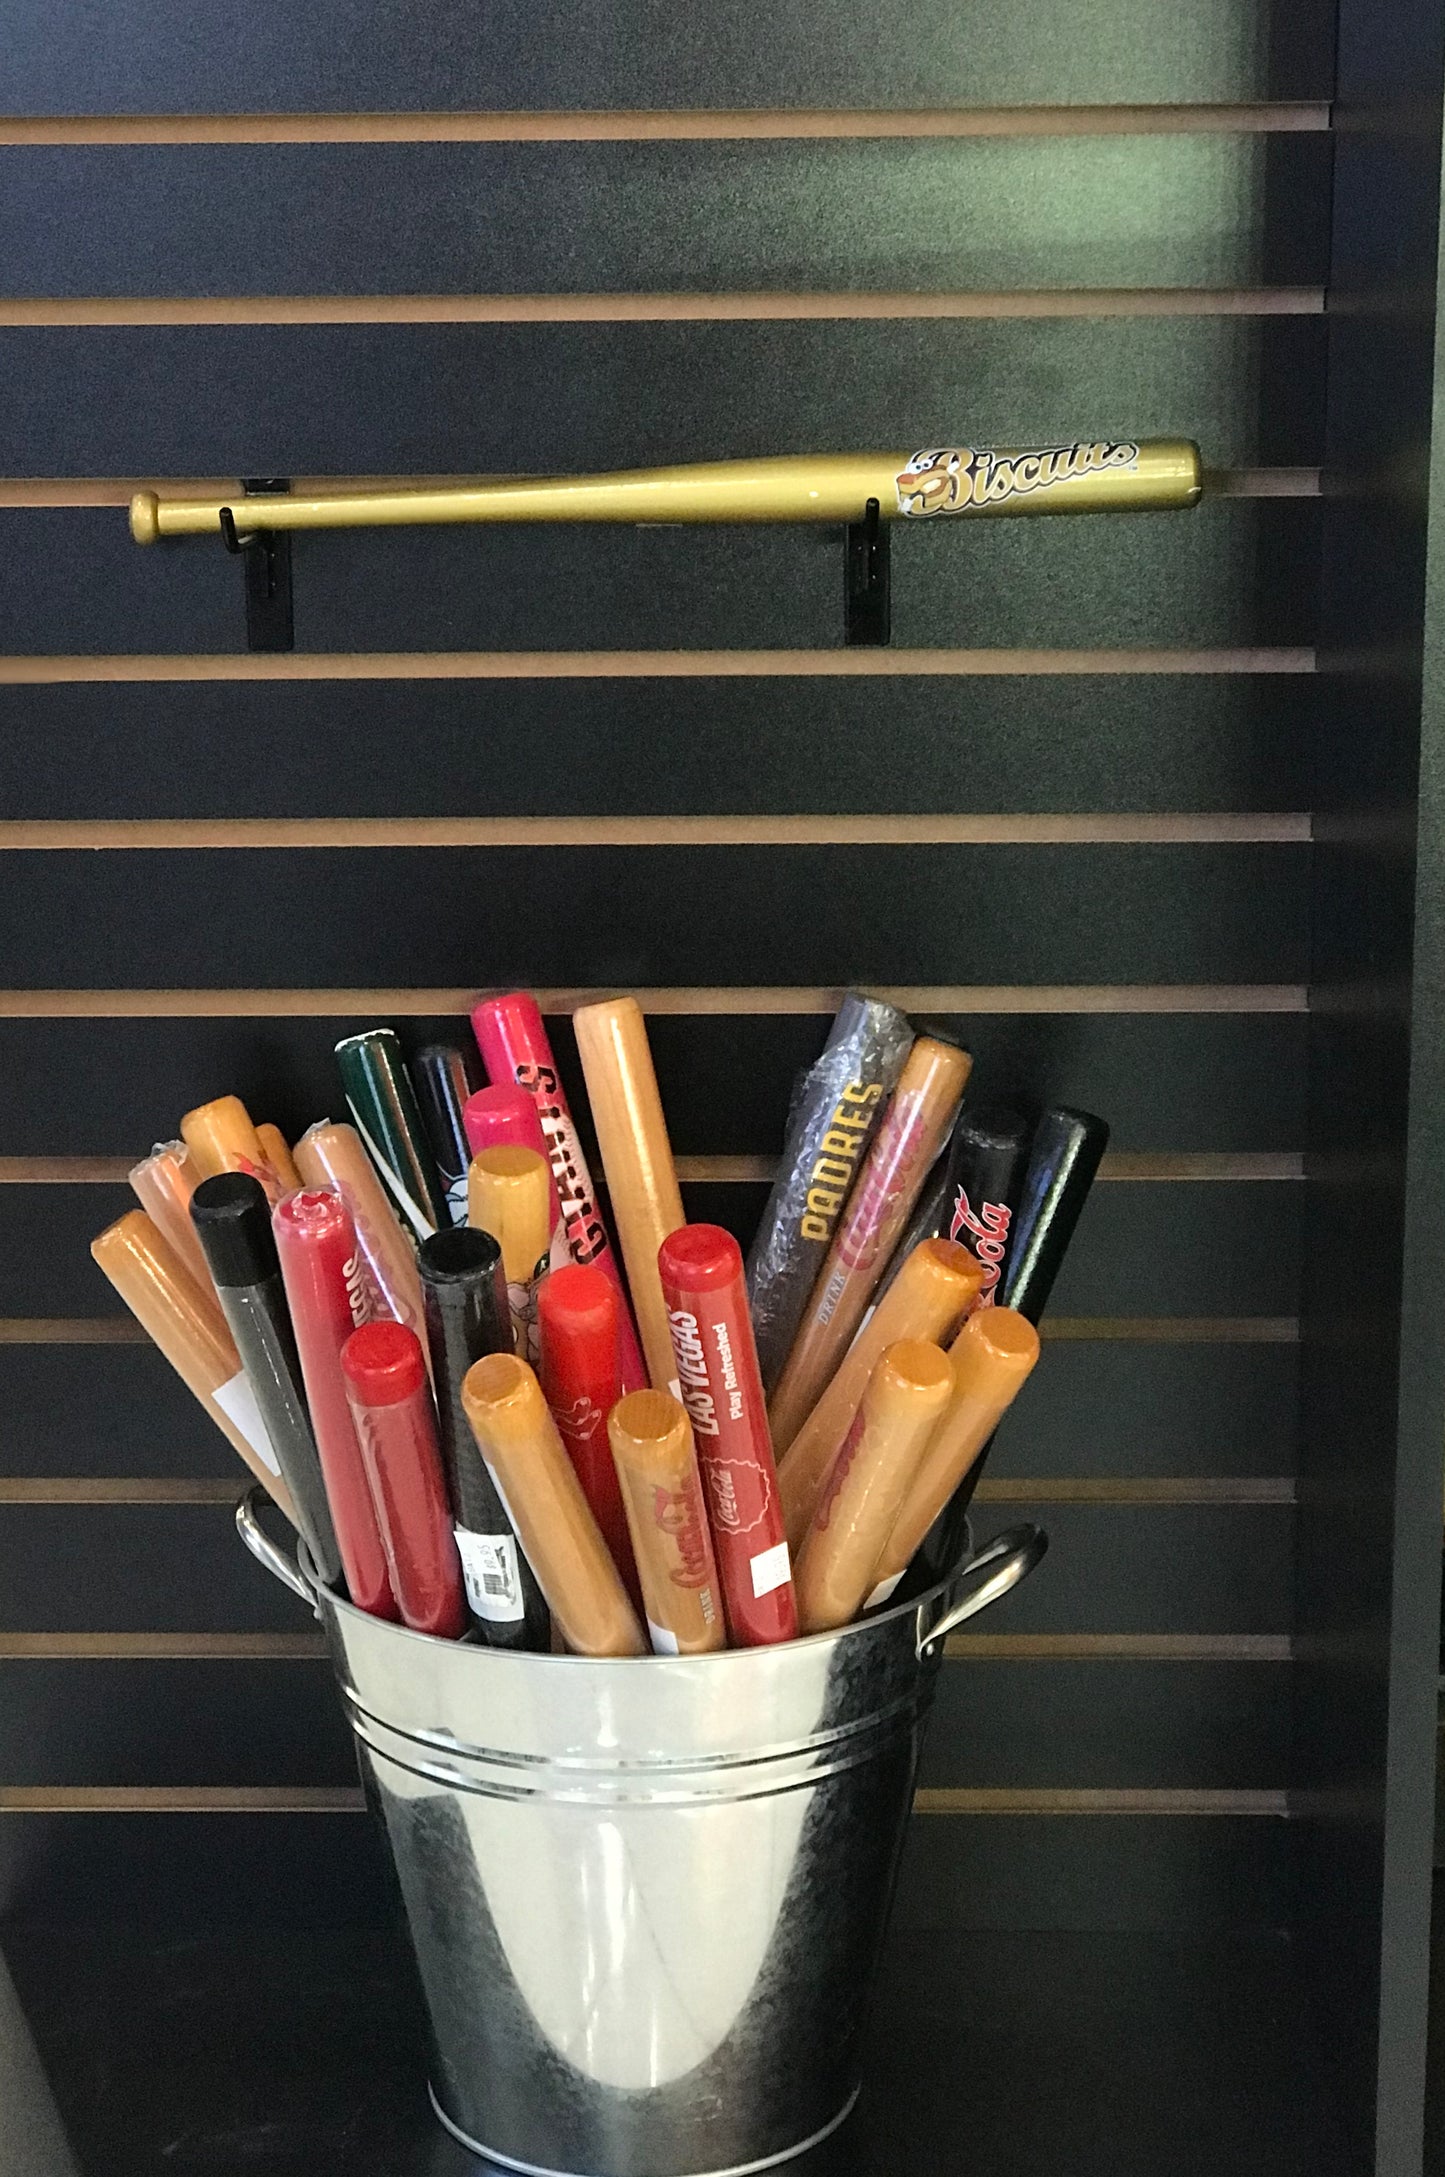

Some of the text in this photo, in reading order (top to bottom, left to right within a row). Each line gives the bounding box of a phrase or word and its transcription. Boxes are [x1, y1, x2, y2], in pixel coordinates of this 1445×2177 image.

[898, 441, 1139, 518] Biscuits
[801, 1080, 883, 1242] PADRES
[818, 1271, 847, 1326] DRINK
[667, 1304, 720, 1436] LAS VEGAS
[712, 1322, 744, 1421] Play Refreshed
[699, 1588, 716, 1625] DRINK
